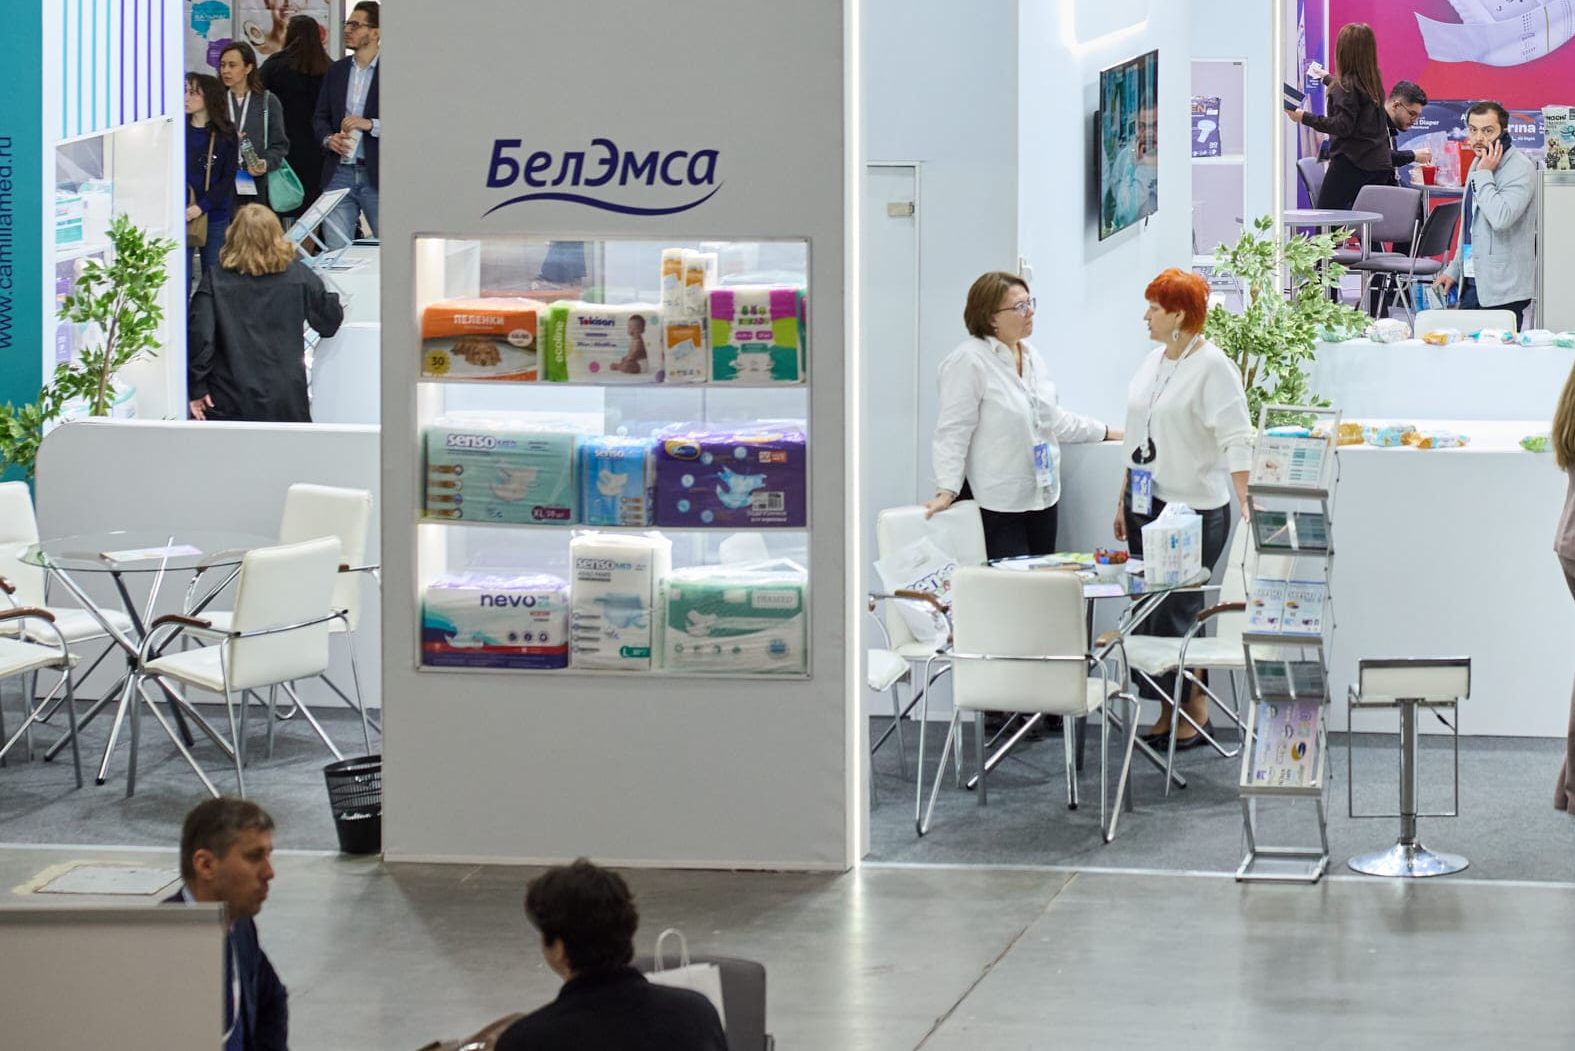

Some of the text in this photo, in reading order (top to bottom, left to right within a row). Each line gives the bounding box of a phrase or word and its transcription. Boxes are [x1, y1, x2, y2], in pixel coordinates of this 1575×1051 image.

[1508, 123, 1536, 133] rina
[485, 137, 720, 188] БелЭмса
[446, 434, 497, 449] senso
[576, 558, 616, 570] senso
[480, 594, 536, 608] nevo
